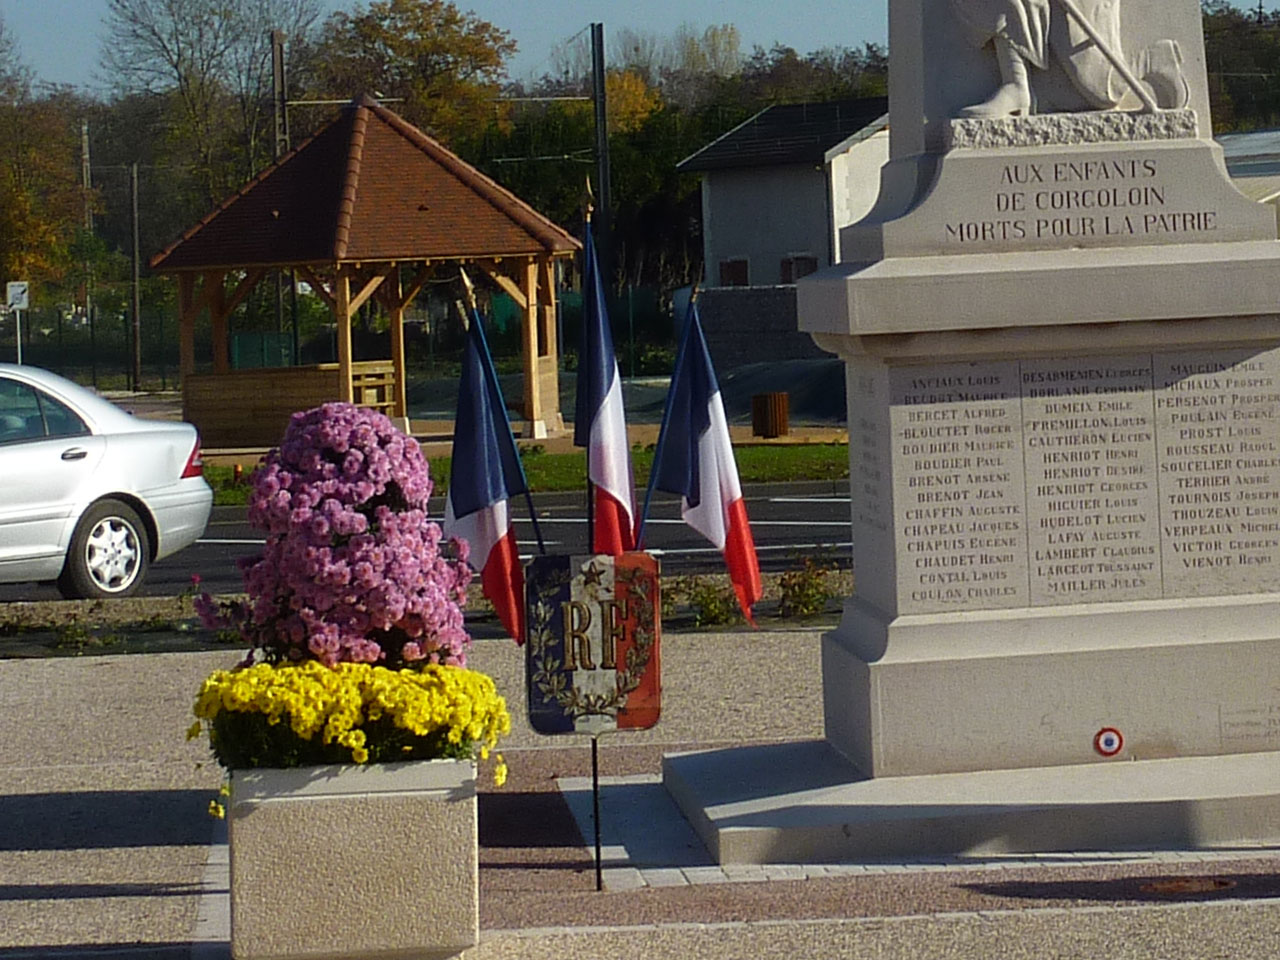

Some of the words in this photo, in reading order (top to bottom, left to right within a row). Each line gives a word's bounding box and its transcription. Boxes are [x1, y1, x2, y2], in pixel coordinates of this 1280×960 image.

[1000, 164, 1044, 185] AUX
[1054, 160, 1157, 182] ENFANTS
[997, 192, 1025, 212] DE
[946, 220, 1026, 242] MORTS
[1036, 217, 1095, 238] POUR
[1105, 215, 1135, 235] LA
[1144, 212, 1217, 232] PATRIE
[560, 599, 629, 671] RF
